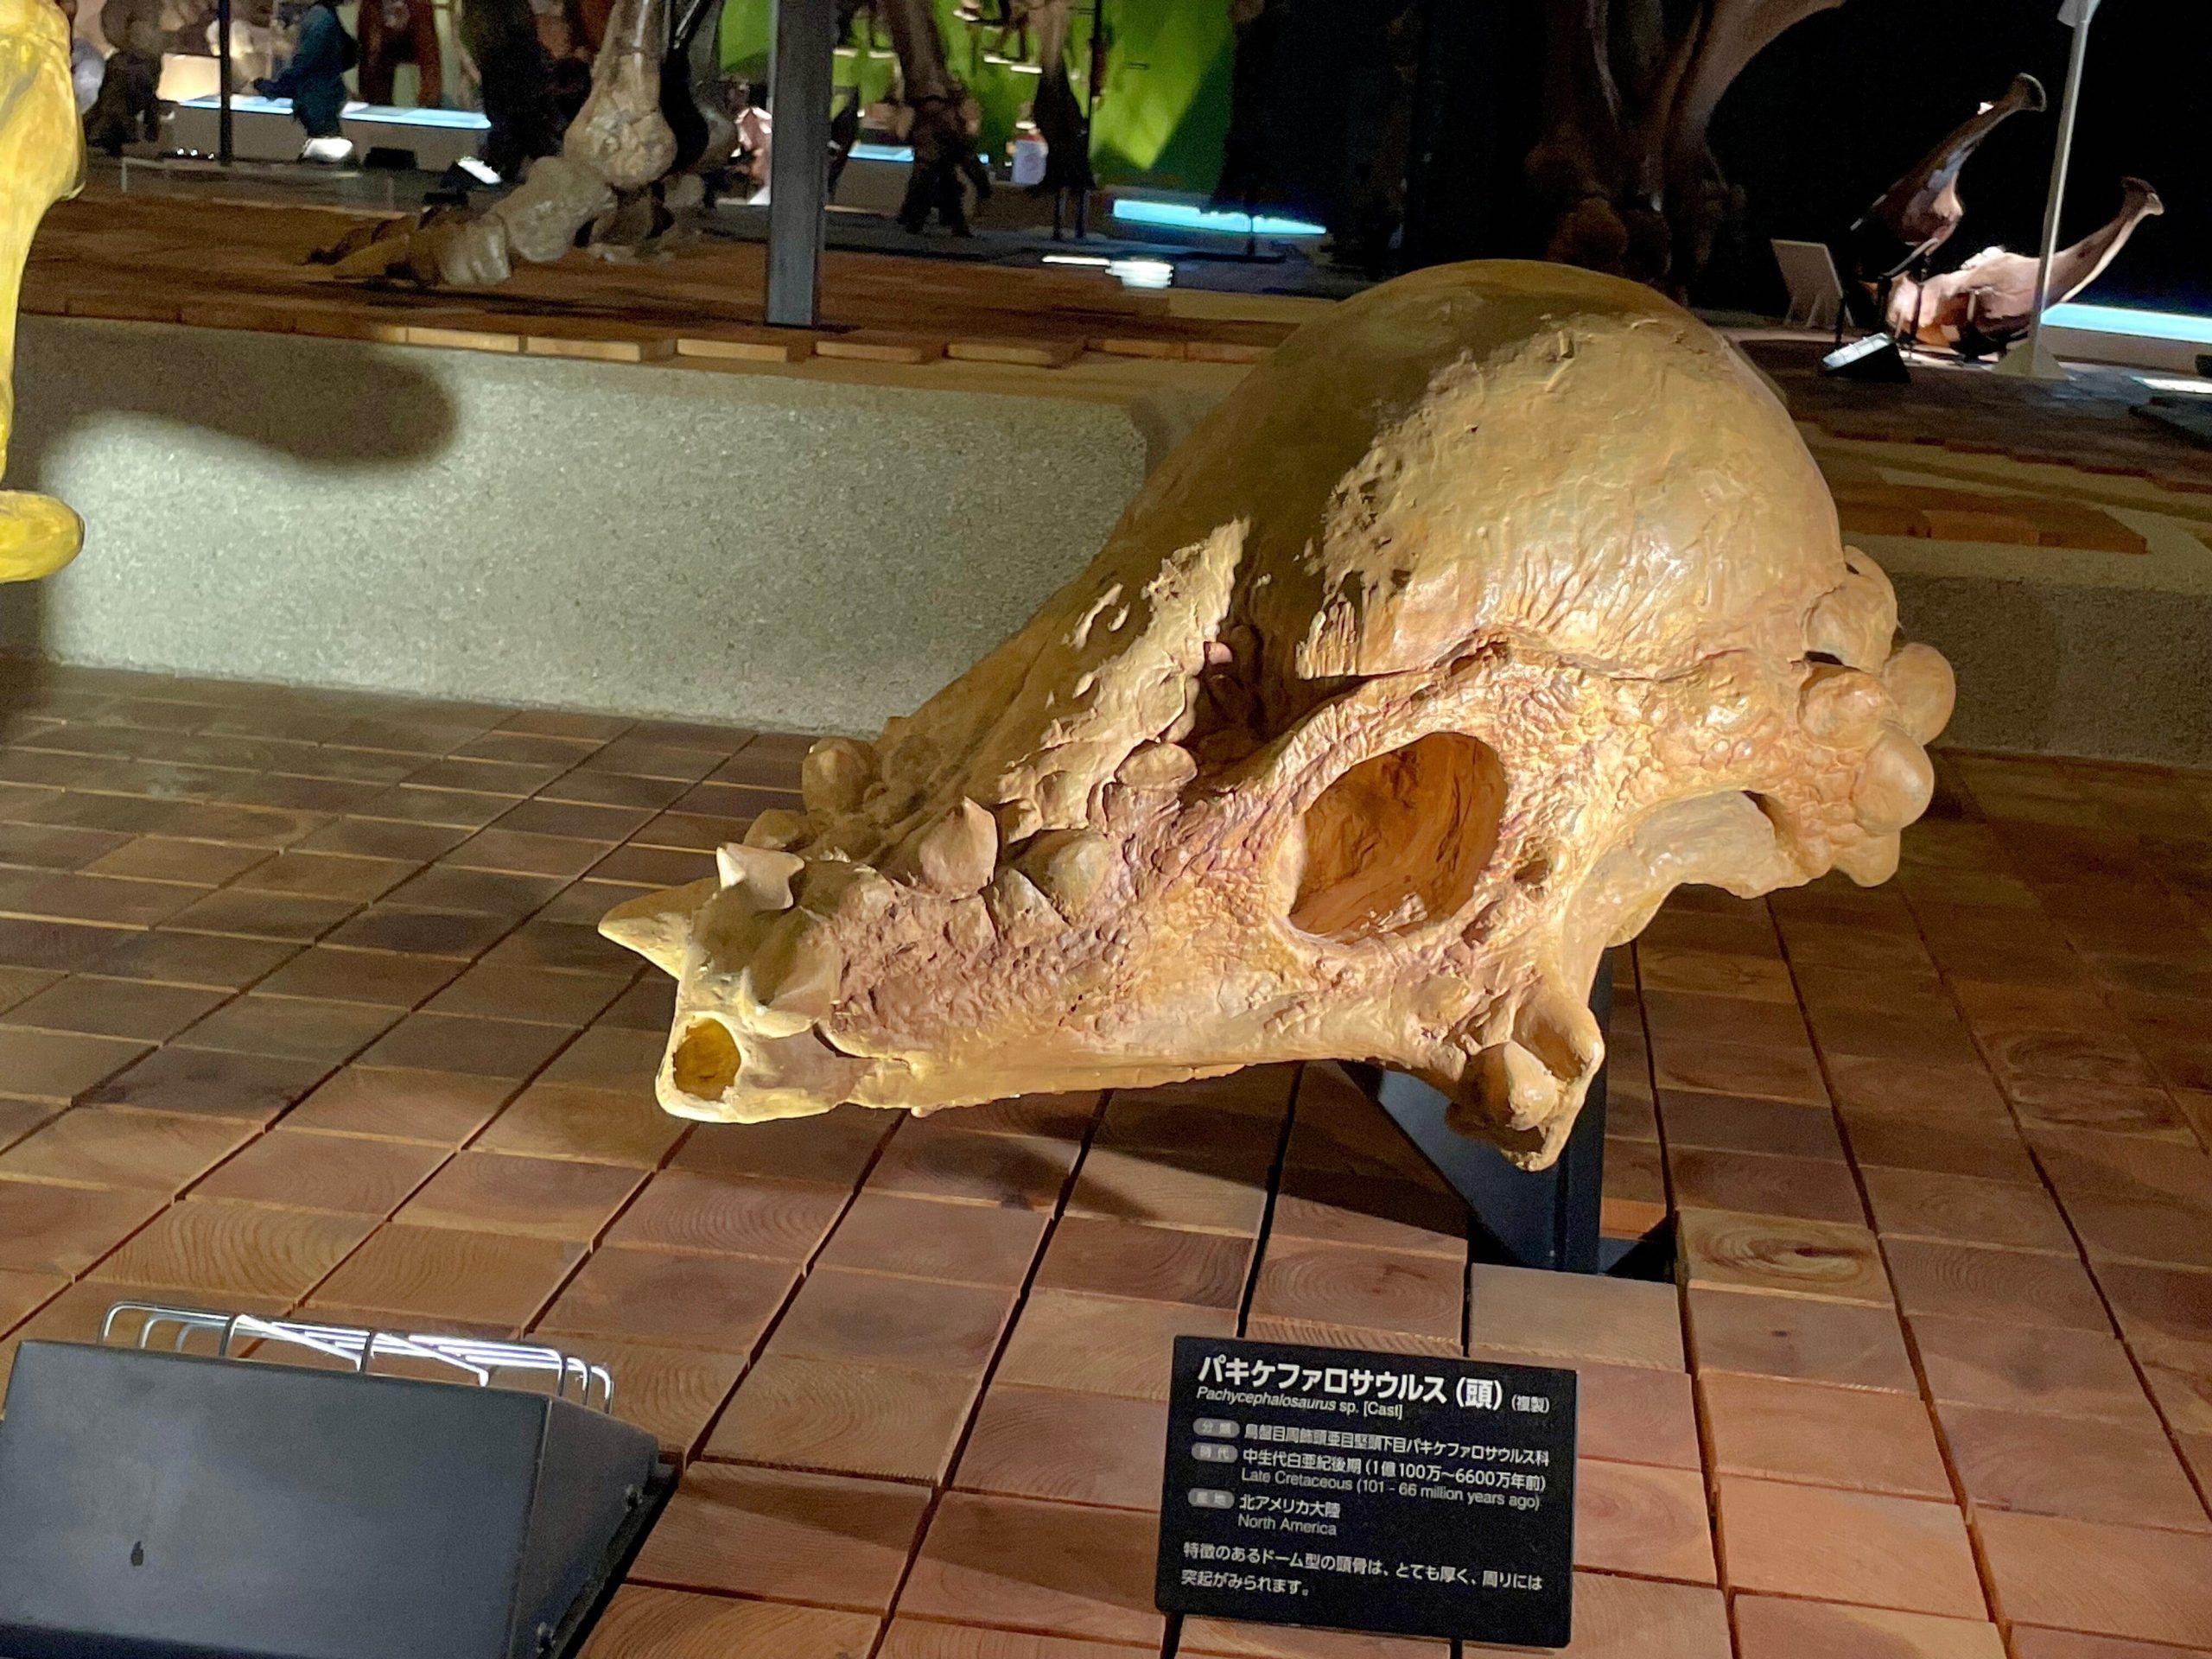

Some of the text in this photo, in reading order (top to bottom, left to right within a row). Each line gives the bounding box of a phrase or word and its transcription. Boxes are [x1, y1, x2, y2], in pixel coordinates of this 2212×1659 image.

[1196, 1385, 1403, 1421] Pachycephalosaurus sp. [Cast]
[1241, 1467, 1270, 1484] Late
[1274, 1471, 1353, 1491] Cretaceous
[1357, 1478, 1383, 1494] (101
[1398, 1482, 1417, 1497] 66
[1421, 1484, 1464, 1502] million
[1467, 1491, 1505, 1506] years
[1509, 1495, 1540, 1511] ago)
[1239, 1493, 1340, 1518] 北アメリカ大陸
[1237, 1514, 1338, 1536] North America
[1181, 1569, 1309, 1597] 突起がみられます。
